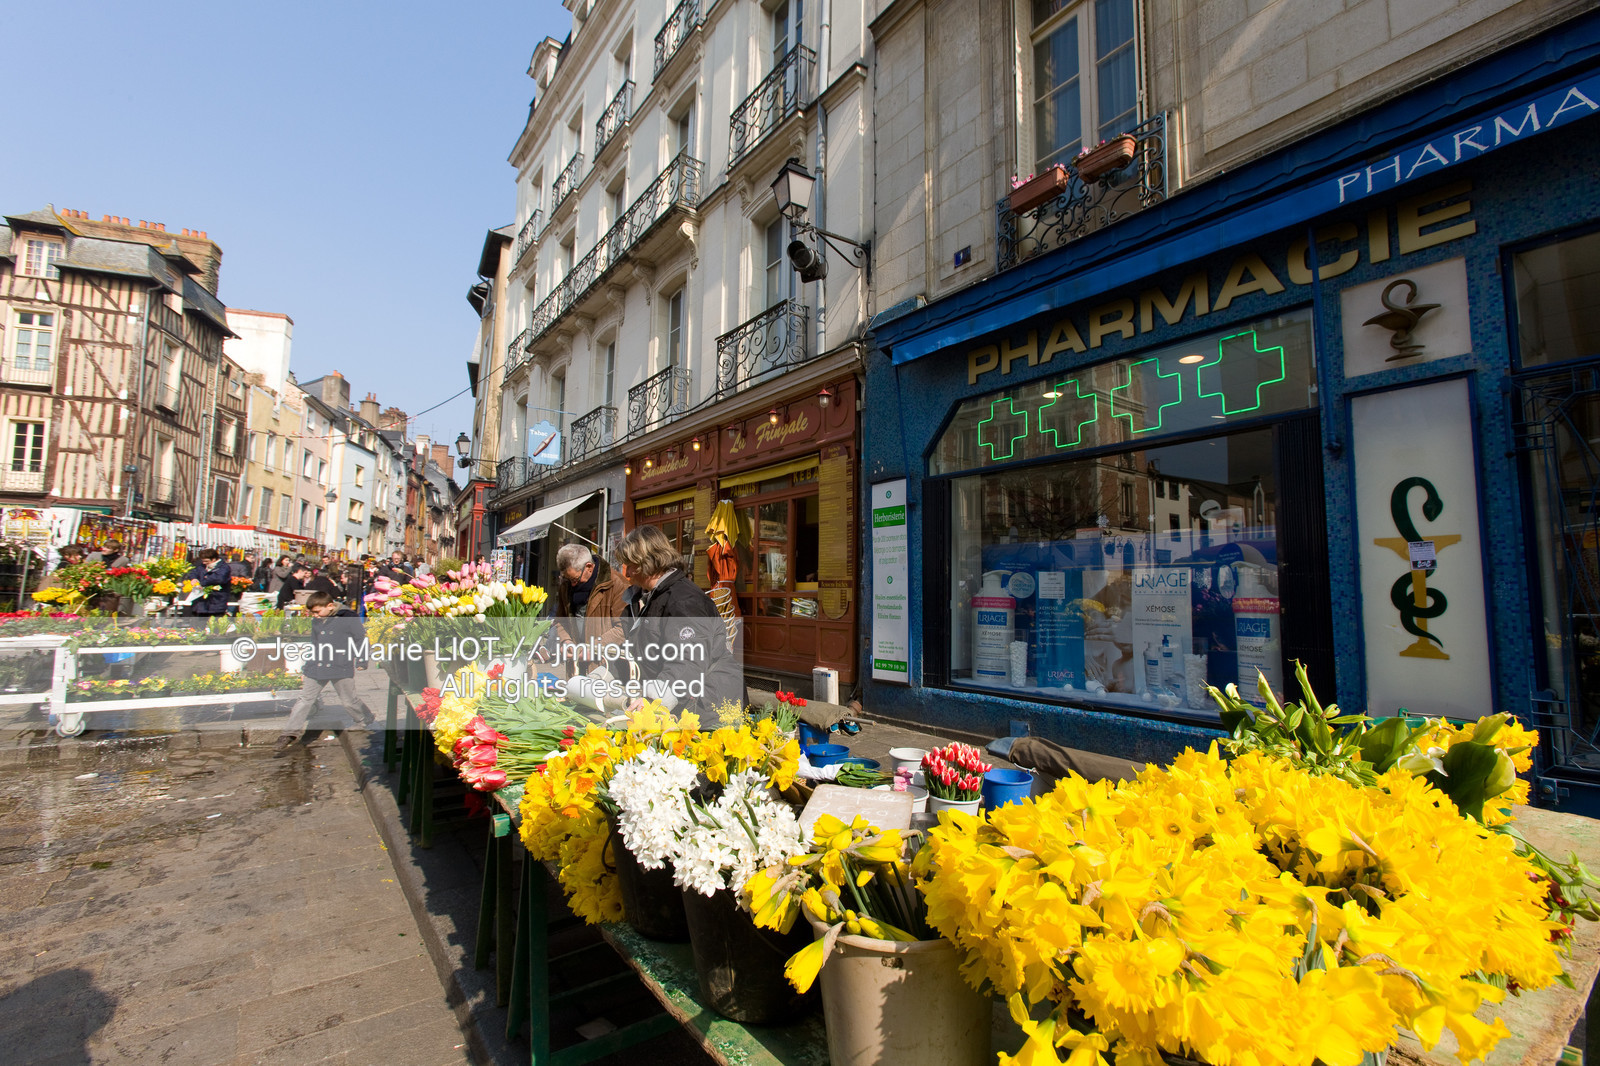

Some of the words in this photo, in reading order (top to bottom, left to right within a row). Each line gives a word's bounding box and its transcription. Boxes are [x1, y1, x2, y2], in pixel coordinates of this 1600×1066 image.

[1337, 86, 1600, 204] PHARMA
[966, 181, 1477, 386] PHARMACIE
[530, 429, 548, 437] Tabac
[730, 432, 746, 454] La
[755, 411, 809, 450] Fringale
[874, 510, 904, 522] Herboristerie
[1136, 572, 1187, 589] URIAGE
[1146, 604, 1175, 613] XÉMOSE
[979, 614, 1006, 623] URIAGE
